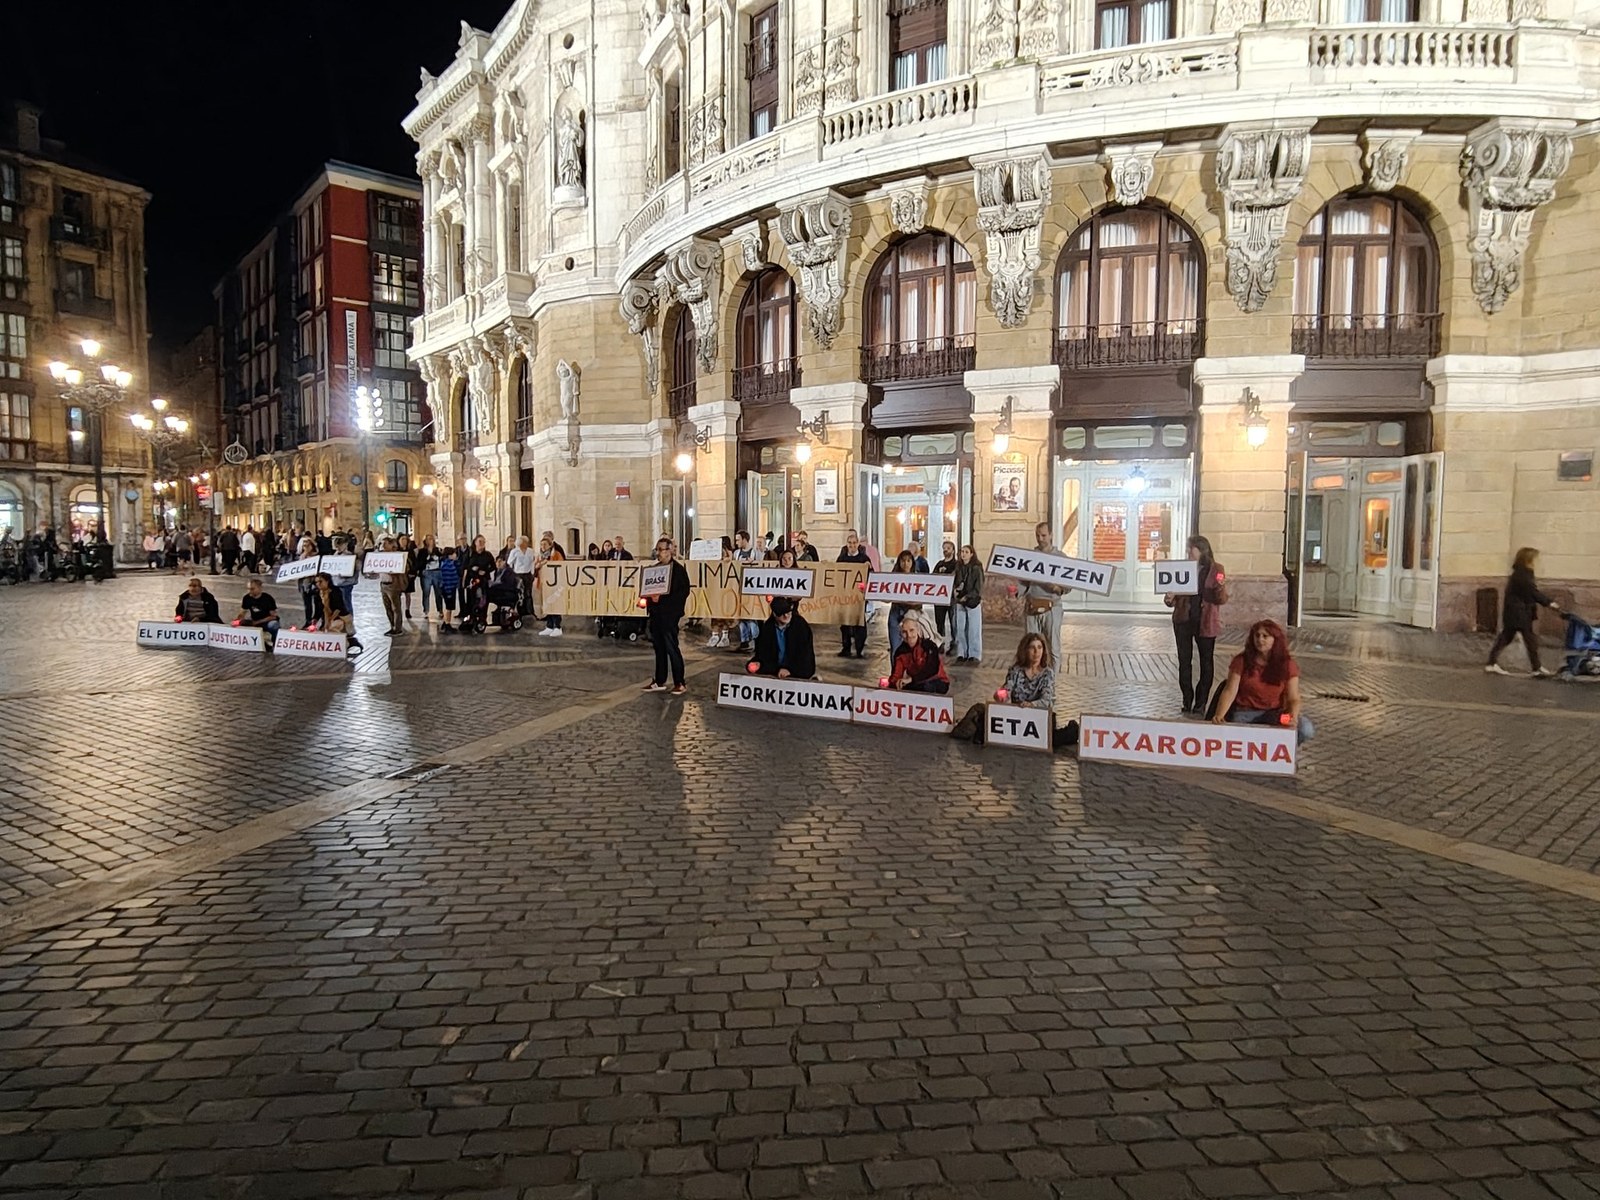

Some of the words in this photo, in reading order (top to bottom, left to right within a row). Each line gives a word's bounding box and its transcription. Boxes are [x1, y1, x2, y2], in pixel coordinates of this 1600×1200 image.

[279, 570, 288, 578] EL
[290, 562, 316, 575] CLIMA
[546, 564, 639, 587] JUSTIZ
[824, 569, 863, 590] ETA
[991, 554, 1105, 586] ESKATZEN
[1158, 571, 1190, 586] DU
[744, 576, 808, 591] KLIMAK
[868, 580, 949, 598] EKINTZA
[139, 627, 153, 638] EL
[157, 630, 206, 641] FUTURO
[210, 633, 249, 646] JUSTICIA
[250, 636, 258, 646] Y
[276, 638, 342, 652] ESPERANZA
[719, 682, 853, 712] ETORKIZUNAK
[855, 699, 953, 724] JUSTIZIA
[990, 716, 1039, 739] ETA
[1082, 729, 1293, 763] ITXAROPENA
